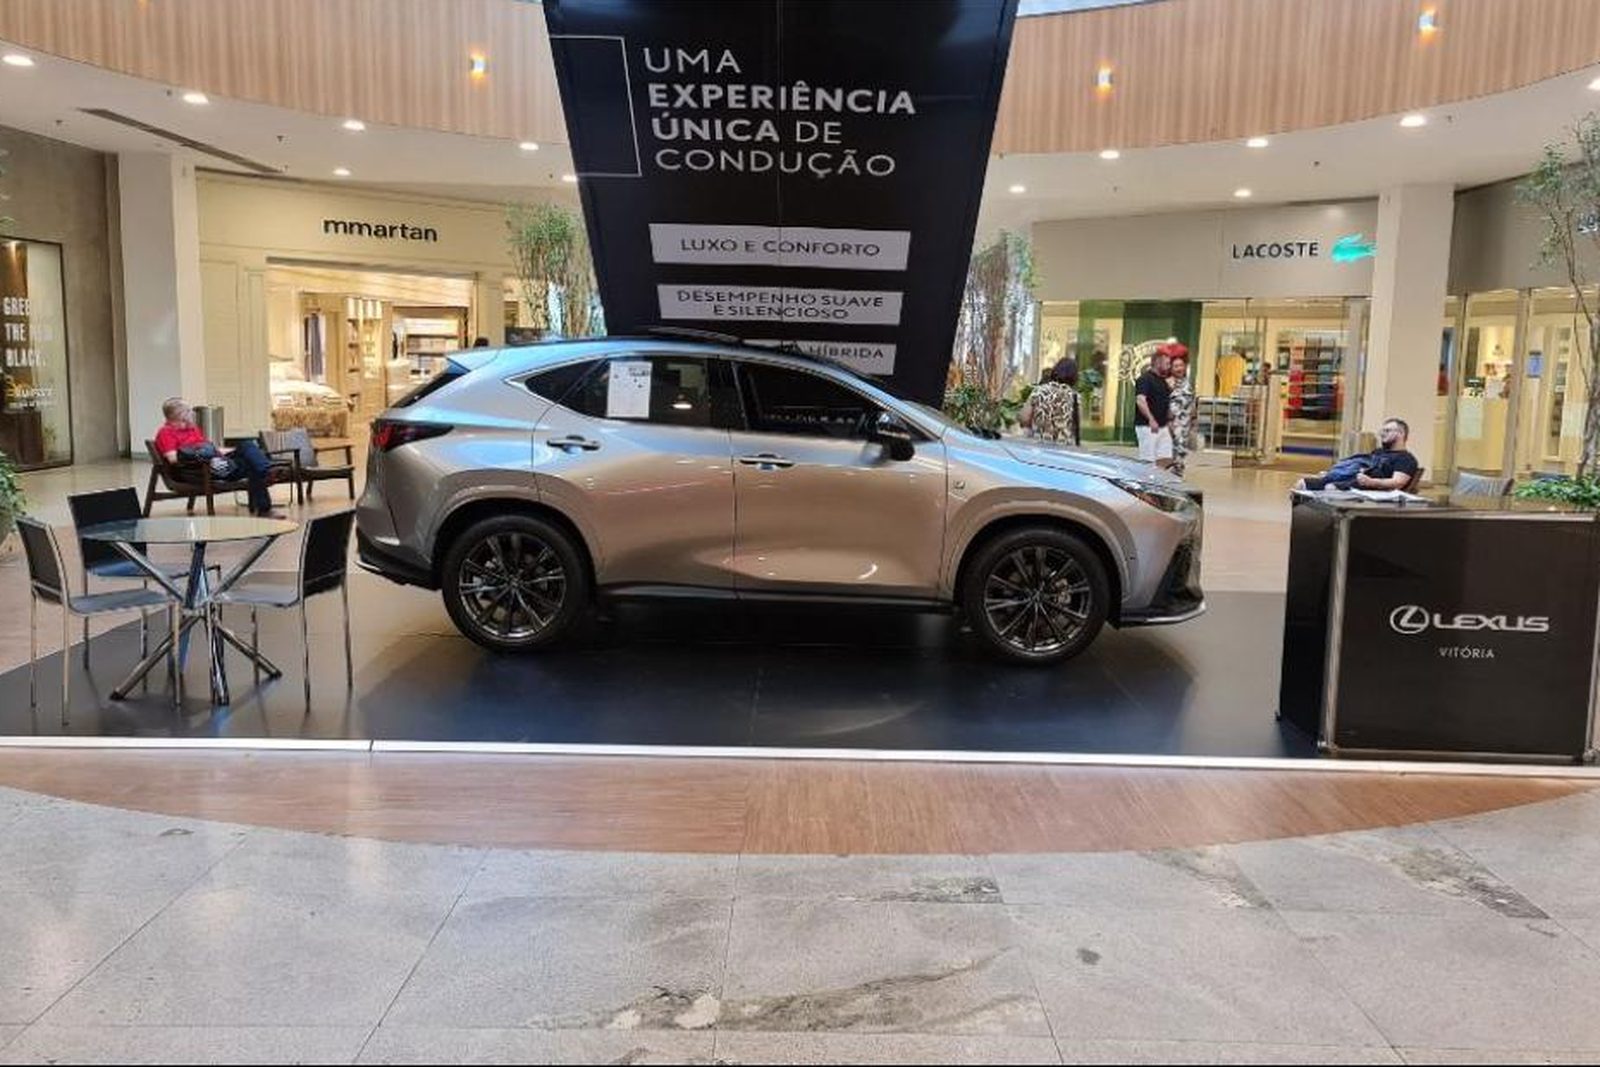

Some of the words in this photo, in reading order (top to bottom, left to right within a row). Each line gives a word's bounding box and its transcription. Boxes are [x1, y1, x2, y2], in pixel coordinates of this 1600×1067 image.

[644, 47, 741, 74] UMA
[648, 80, 916, 115] EXPERIÊNCIA
[651, 111, 780, 142] ÚNICA
[795, 120, 842, 144] DE
[655, 149, 896, 178] CONDUÇÃO
[323, 219, 437, 242] mmartan
[681, 238, 738, 252] LUXO
[744, 240, 757, 253] E
[763, 240, 881, 257] CONFORTO
[1232, 242, 1319, 259] LACOSTE
[677, 289, 817, 306] DESEMPENHO
[821, 295, 884, 308] SUAVE
[713, 305, 725, 316] E
[728, 305, 849, 320] SILENCIOSO
[1432, 613, 1549, 632] LEXUS
[1438, 645, 1495, 659] VITÓRIA
